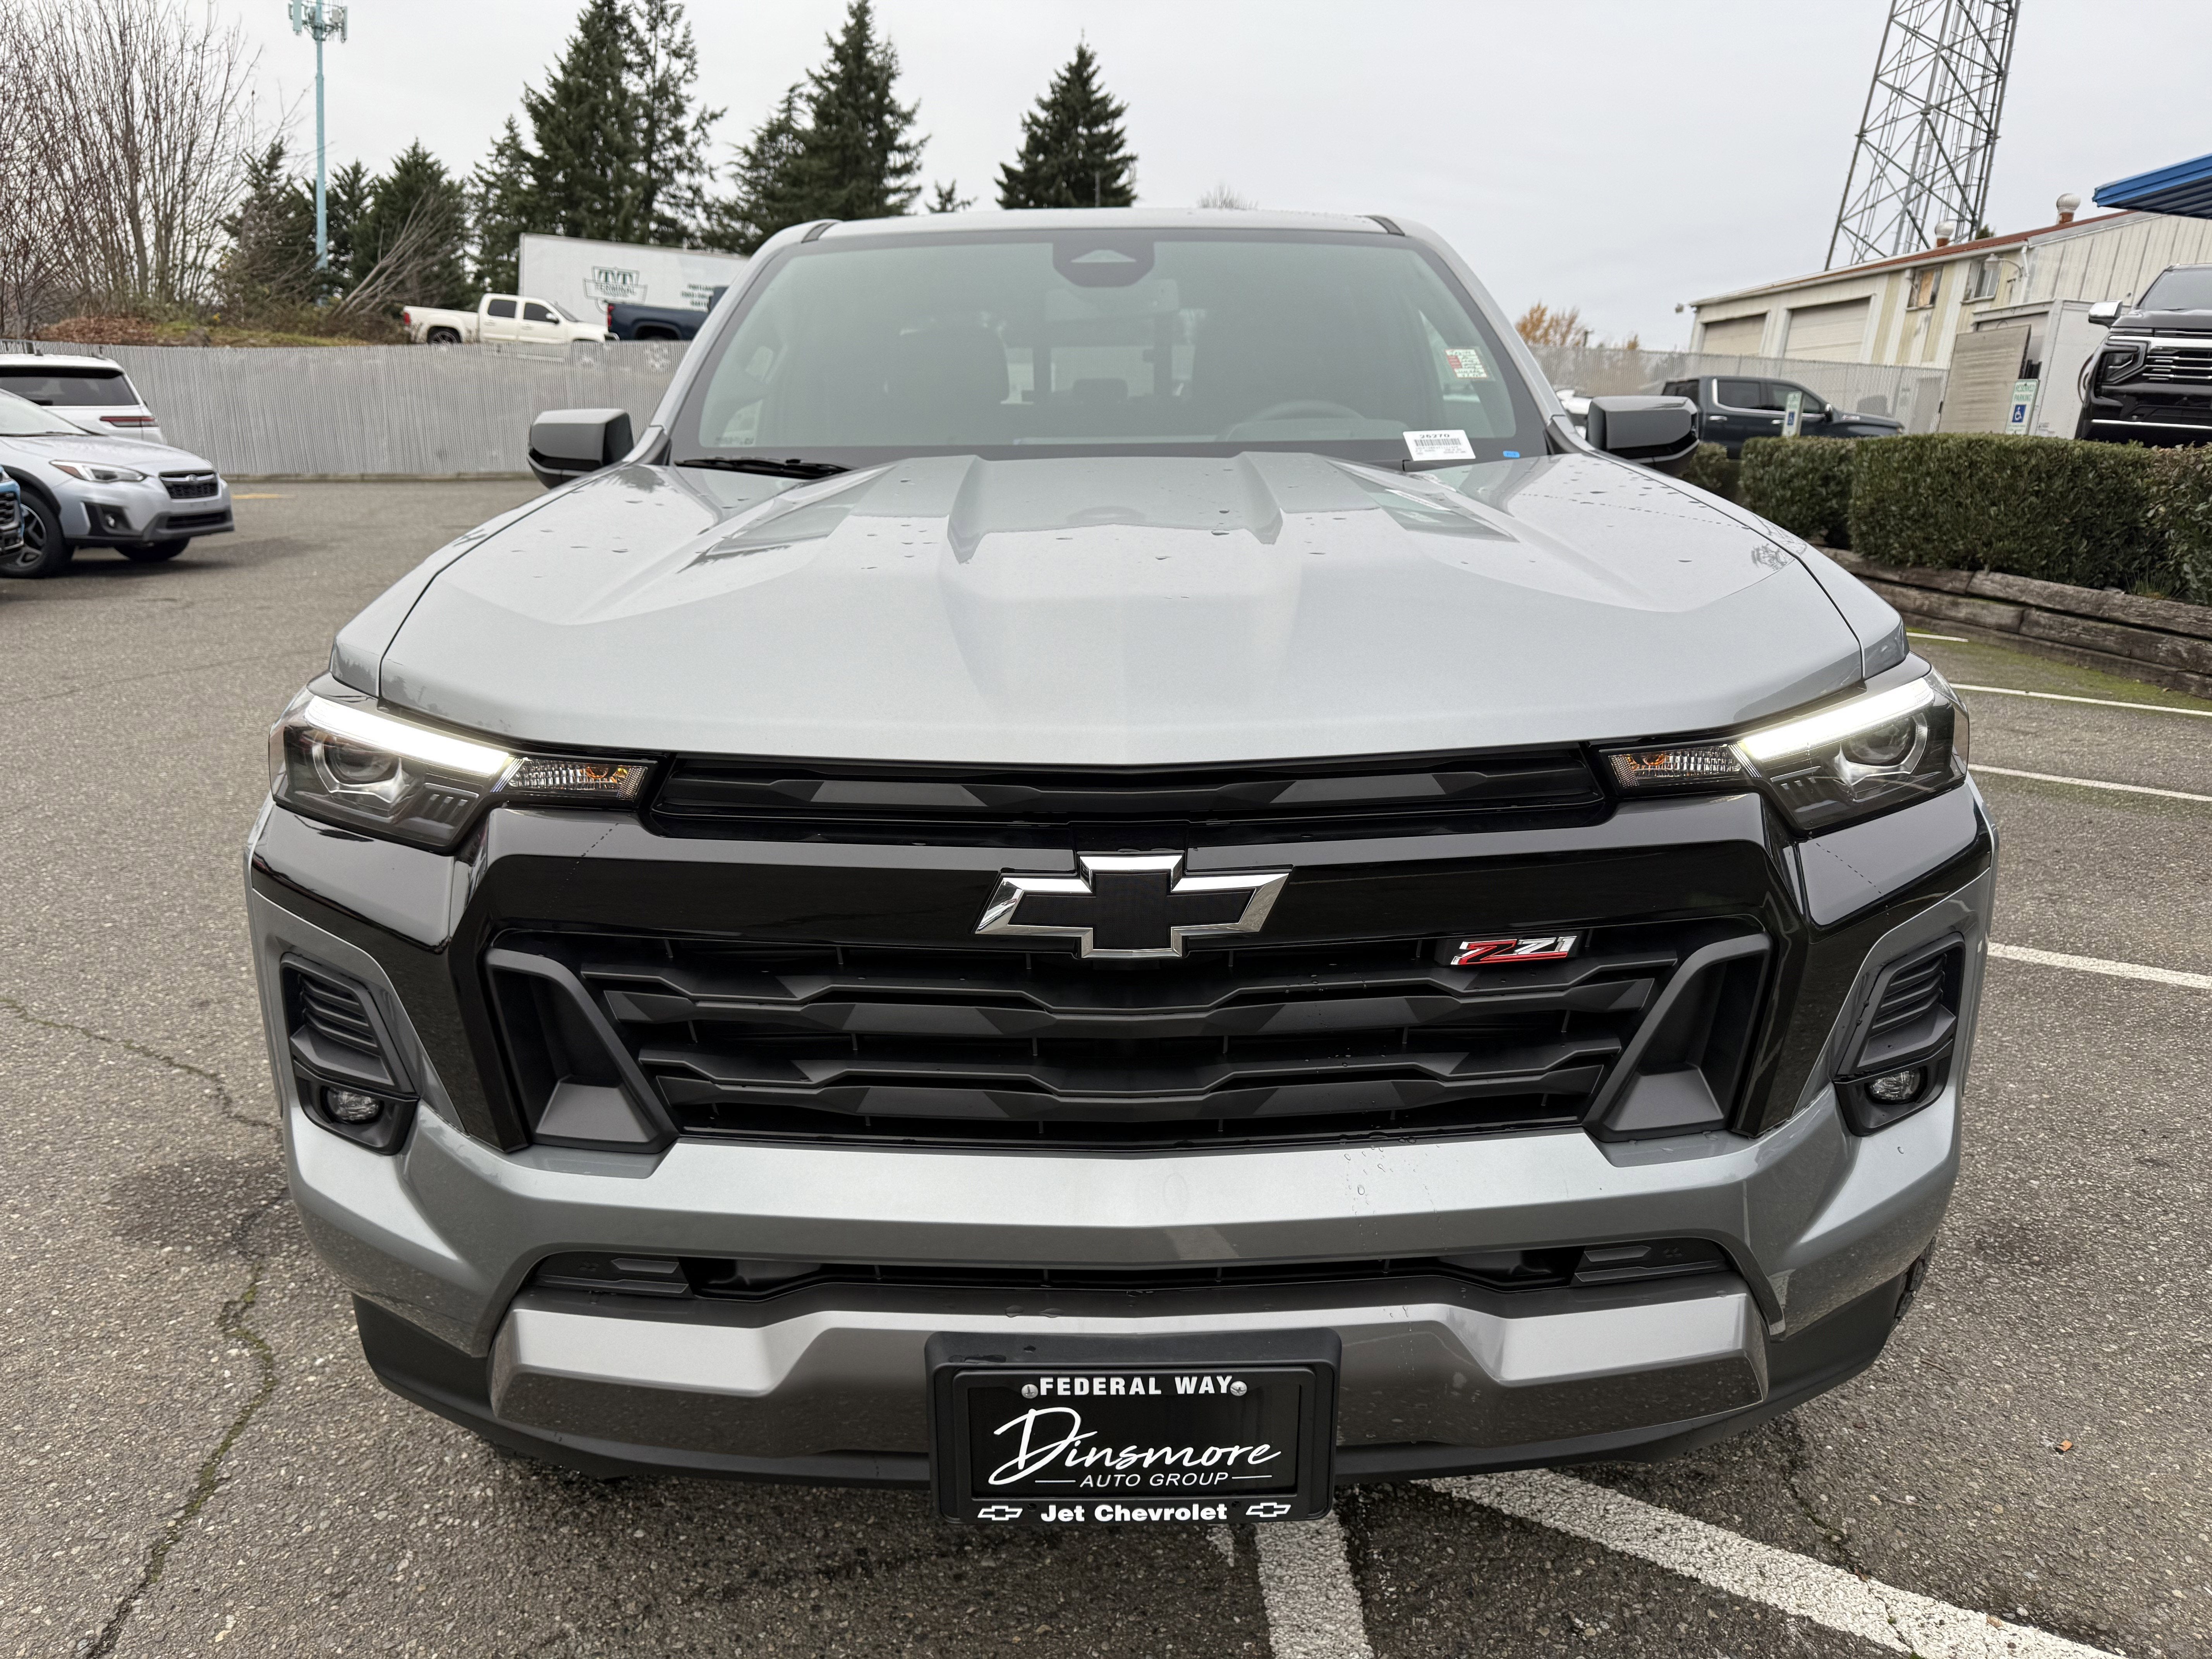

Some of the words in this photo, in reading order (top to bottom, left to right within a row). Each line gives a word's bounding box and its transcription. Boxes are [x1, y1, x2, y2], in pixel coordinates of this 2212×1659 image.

[1450, 936, 1577, 965] Z71
[1040, 1377, 1161, 1395] FEDERAL
[1175, 1376, 1232, 1394] WAY
[988, 1407, 1281, 1485] Dinsmore
[1080, 1474, 1140, 1487] AUTO
[1149, 1472, 1228, 1486] GROUP
[1041, 1505, 1085, 1522] Jet
[1094, 1503, 1227, 1522] Chevrolet
